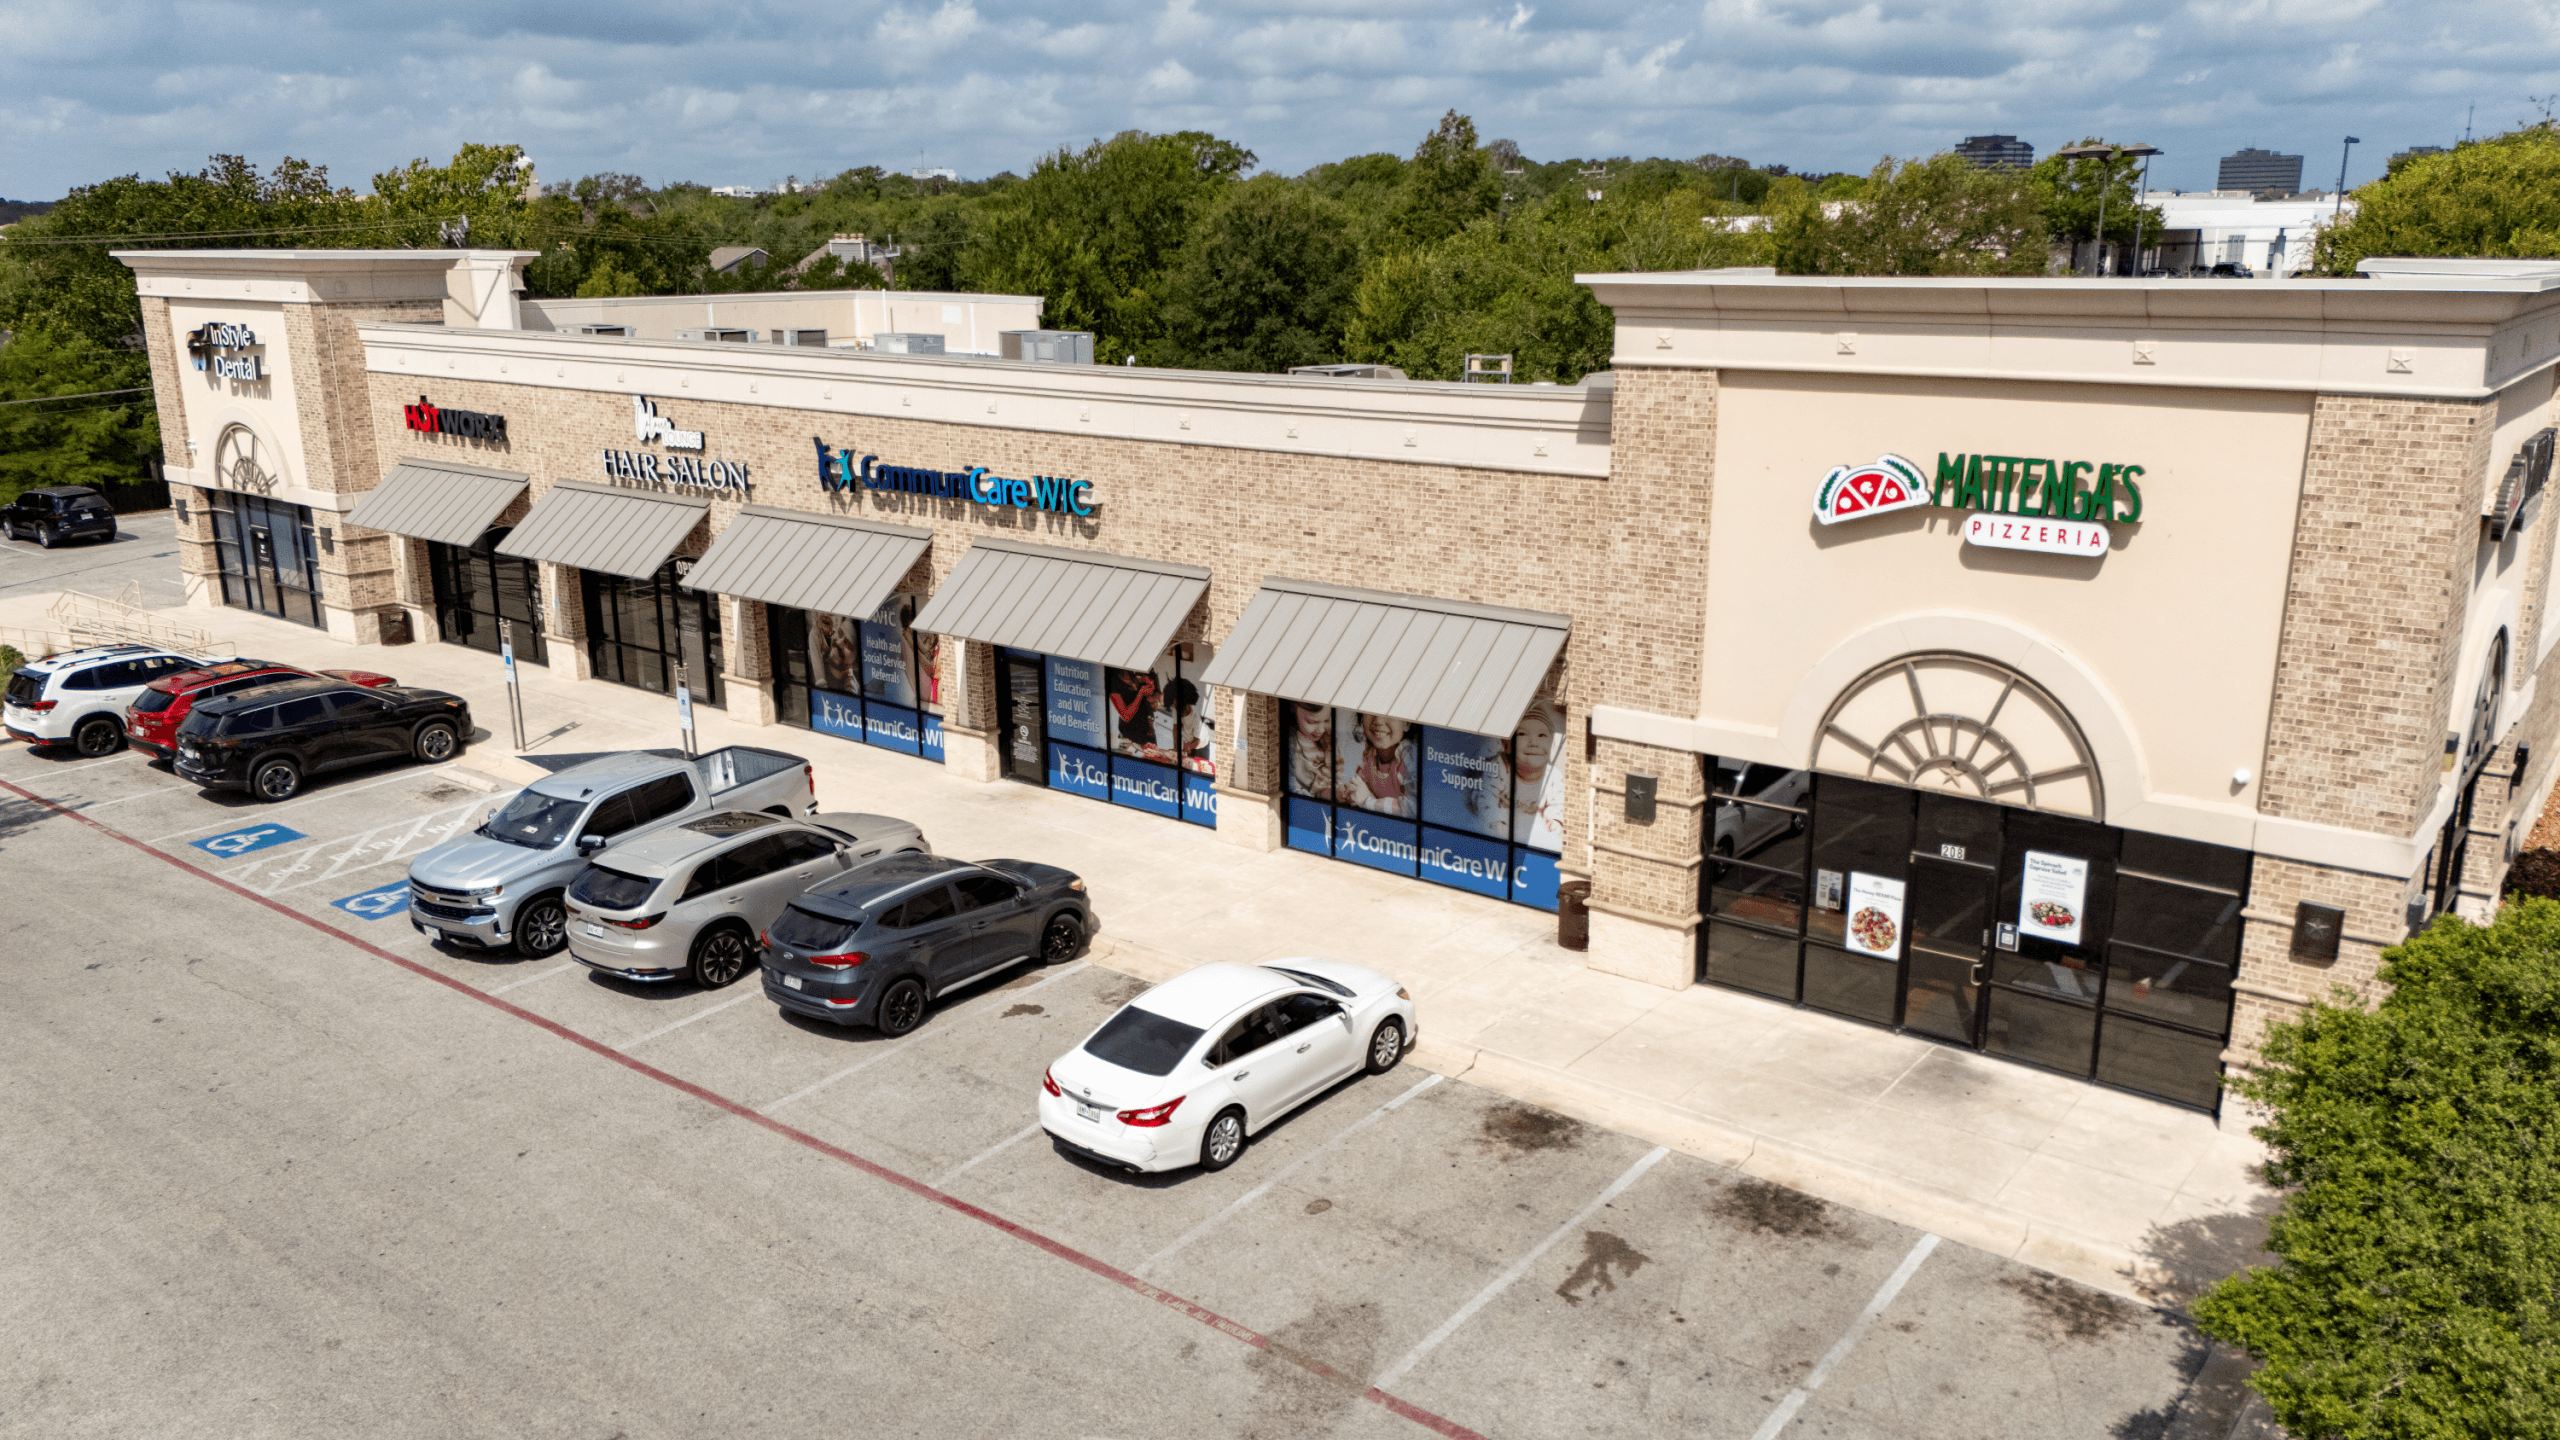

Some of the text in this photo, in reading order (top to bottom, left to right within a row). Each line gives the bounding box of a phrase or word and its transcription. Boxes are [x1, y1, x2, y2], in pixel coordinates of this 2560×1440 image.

[209, 324, 251, 352] InStyle
[213, 355, 257, 380] Dental
[404, 398, 503, 441] HOTWORX
[662, 431, 701, 447] LOUNGE
[602, 450, 747, 492] HAIR SALON
[861, 455, 1092, 516] CommuniCare WIC
[1932, 452, 2145, 524] MATTENGA'S
[1972, 521, 2101, 548] PIZZERIA
[676, 560, 697, 575] OP
[866, 635, 901, 653] Health and
[863, 650, 882, 665] Social
[871, 667, 900, 684] Referrals
[1054, 662, 1089, 680] Nutrition
[1054, 679, 1092, 698] Education
[1058, 698, 1089, 715] and WIC
[1049, 710, 1099, 733] Food Benefits
[925, 727, 943, 748] WI
[1427, 746, 1499, 778] Breastfeeding
[1441, 768, 1484, 791] Support
[1186, 787, 1217, 814] WIC
[1357, 829, 1528, 889] CommuniCare WC
[1942, 845, 1964, 859] 208
[268, 863, 311, 880] NO
[1163, 1296, 1194, 1315] LANE
[1193, 1309, 1211, 1321] NO
[1212, 1319, 1256, 1342] PARKING
